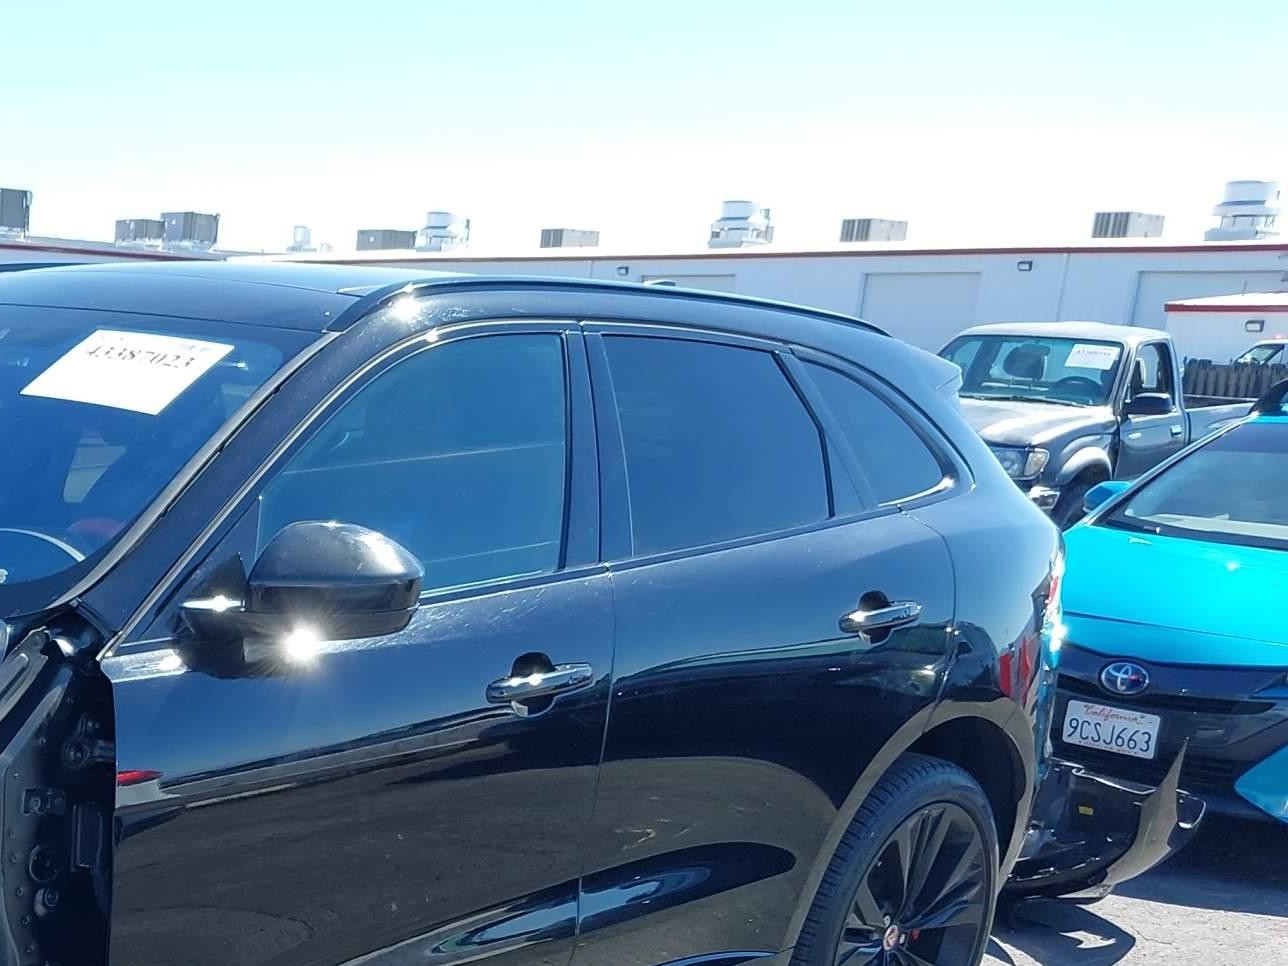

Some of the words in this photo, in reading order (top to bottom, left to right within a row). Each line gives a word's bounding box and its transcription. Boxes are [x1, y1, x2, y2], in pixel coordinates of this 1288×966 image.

[85, 345, 196, 369] 43387023
[1084, 704, 1140, 722] California
[1067, 717, 1152, 753] 9CSJ663
